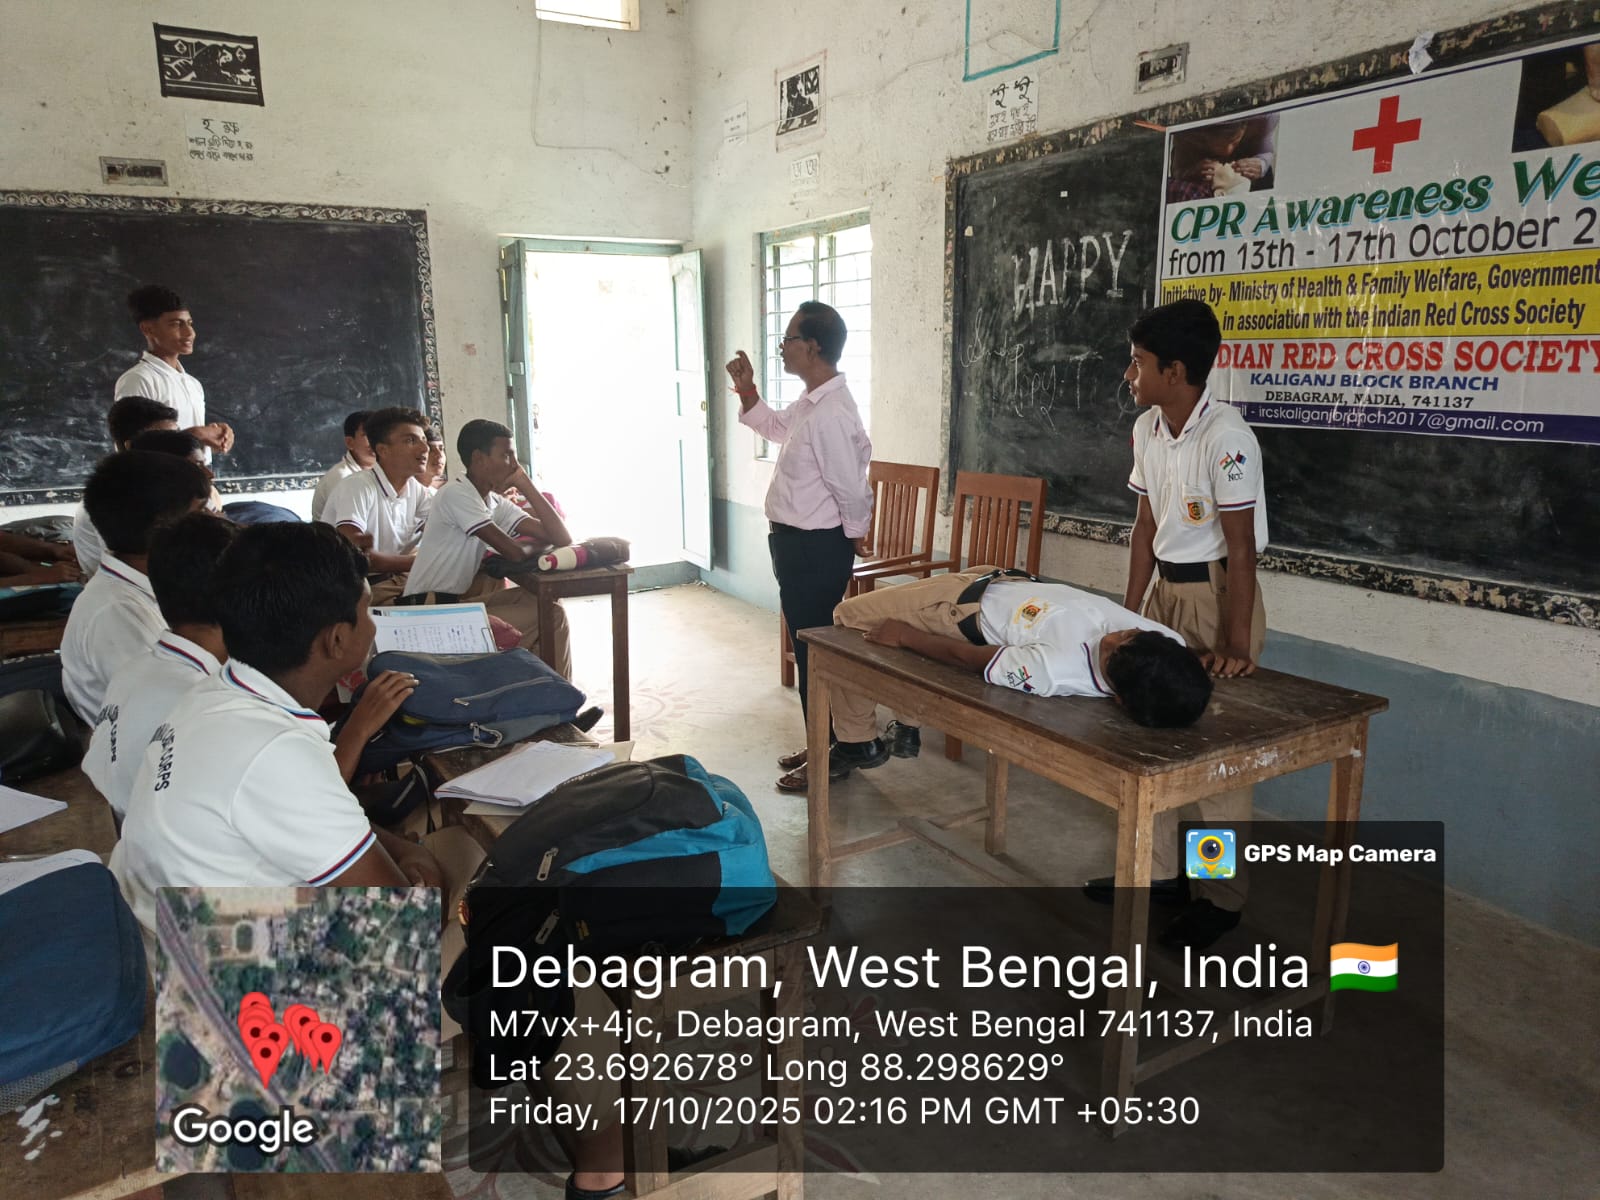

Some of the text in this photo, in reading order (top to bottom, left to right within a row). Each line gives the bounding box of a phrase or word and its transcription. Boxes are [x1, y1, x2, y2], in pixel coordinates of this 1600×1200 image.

[1171, 153, 1600, 244] CPR Awareness We
[1169, 248, 1225, 276] from
[1237, 238, 1295, 270] 13th
[1328, 227, 1396, 263] 17th
[1409, 216, 1560, 257] October
[1573, 207, 1600, 245] 2
[1012, 229, 1133, 320] HAPPY
[1229, 279, 1278, 304] Ministry
[1281, 276, 1296, 298] of
[1297, 274, 1342, 298] Health
[1346, 273, 1357, 295] &
[1361, 270, 1411, 299] Family
[1415, 266, 1482, 295] Welfare,
[1488, 258, 1600, 289] Government
[1223, 297, 1586, 331] in association with the Indian Red Cross Society
[1213, 343, 1275, 370] DIAN
[1281, 342, 1336, 370] RED
[1345, 341, 1444, 371] CROSS
[1250, 373, 1499, 391] KALIGANJ BLOCK BRANCH
[1265, 391, 1474, 409] DEBAGRAM, NADIA, 741137
